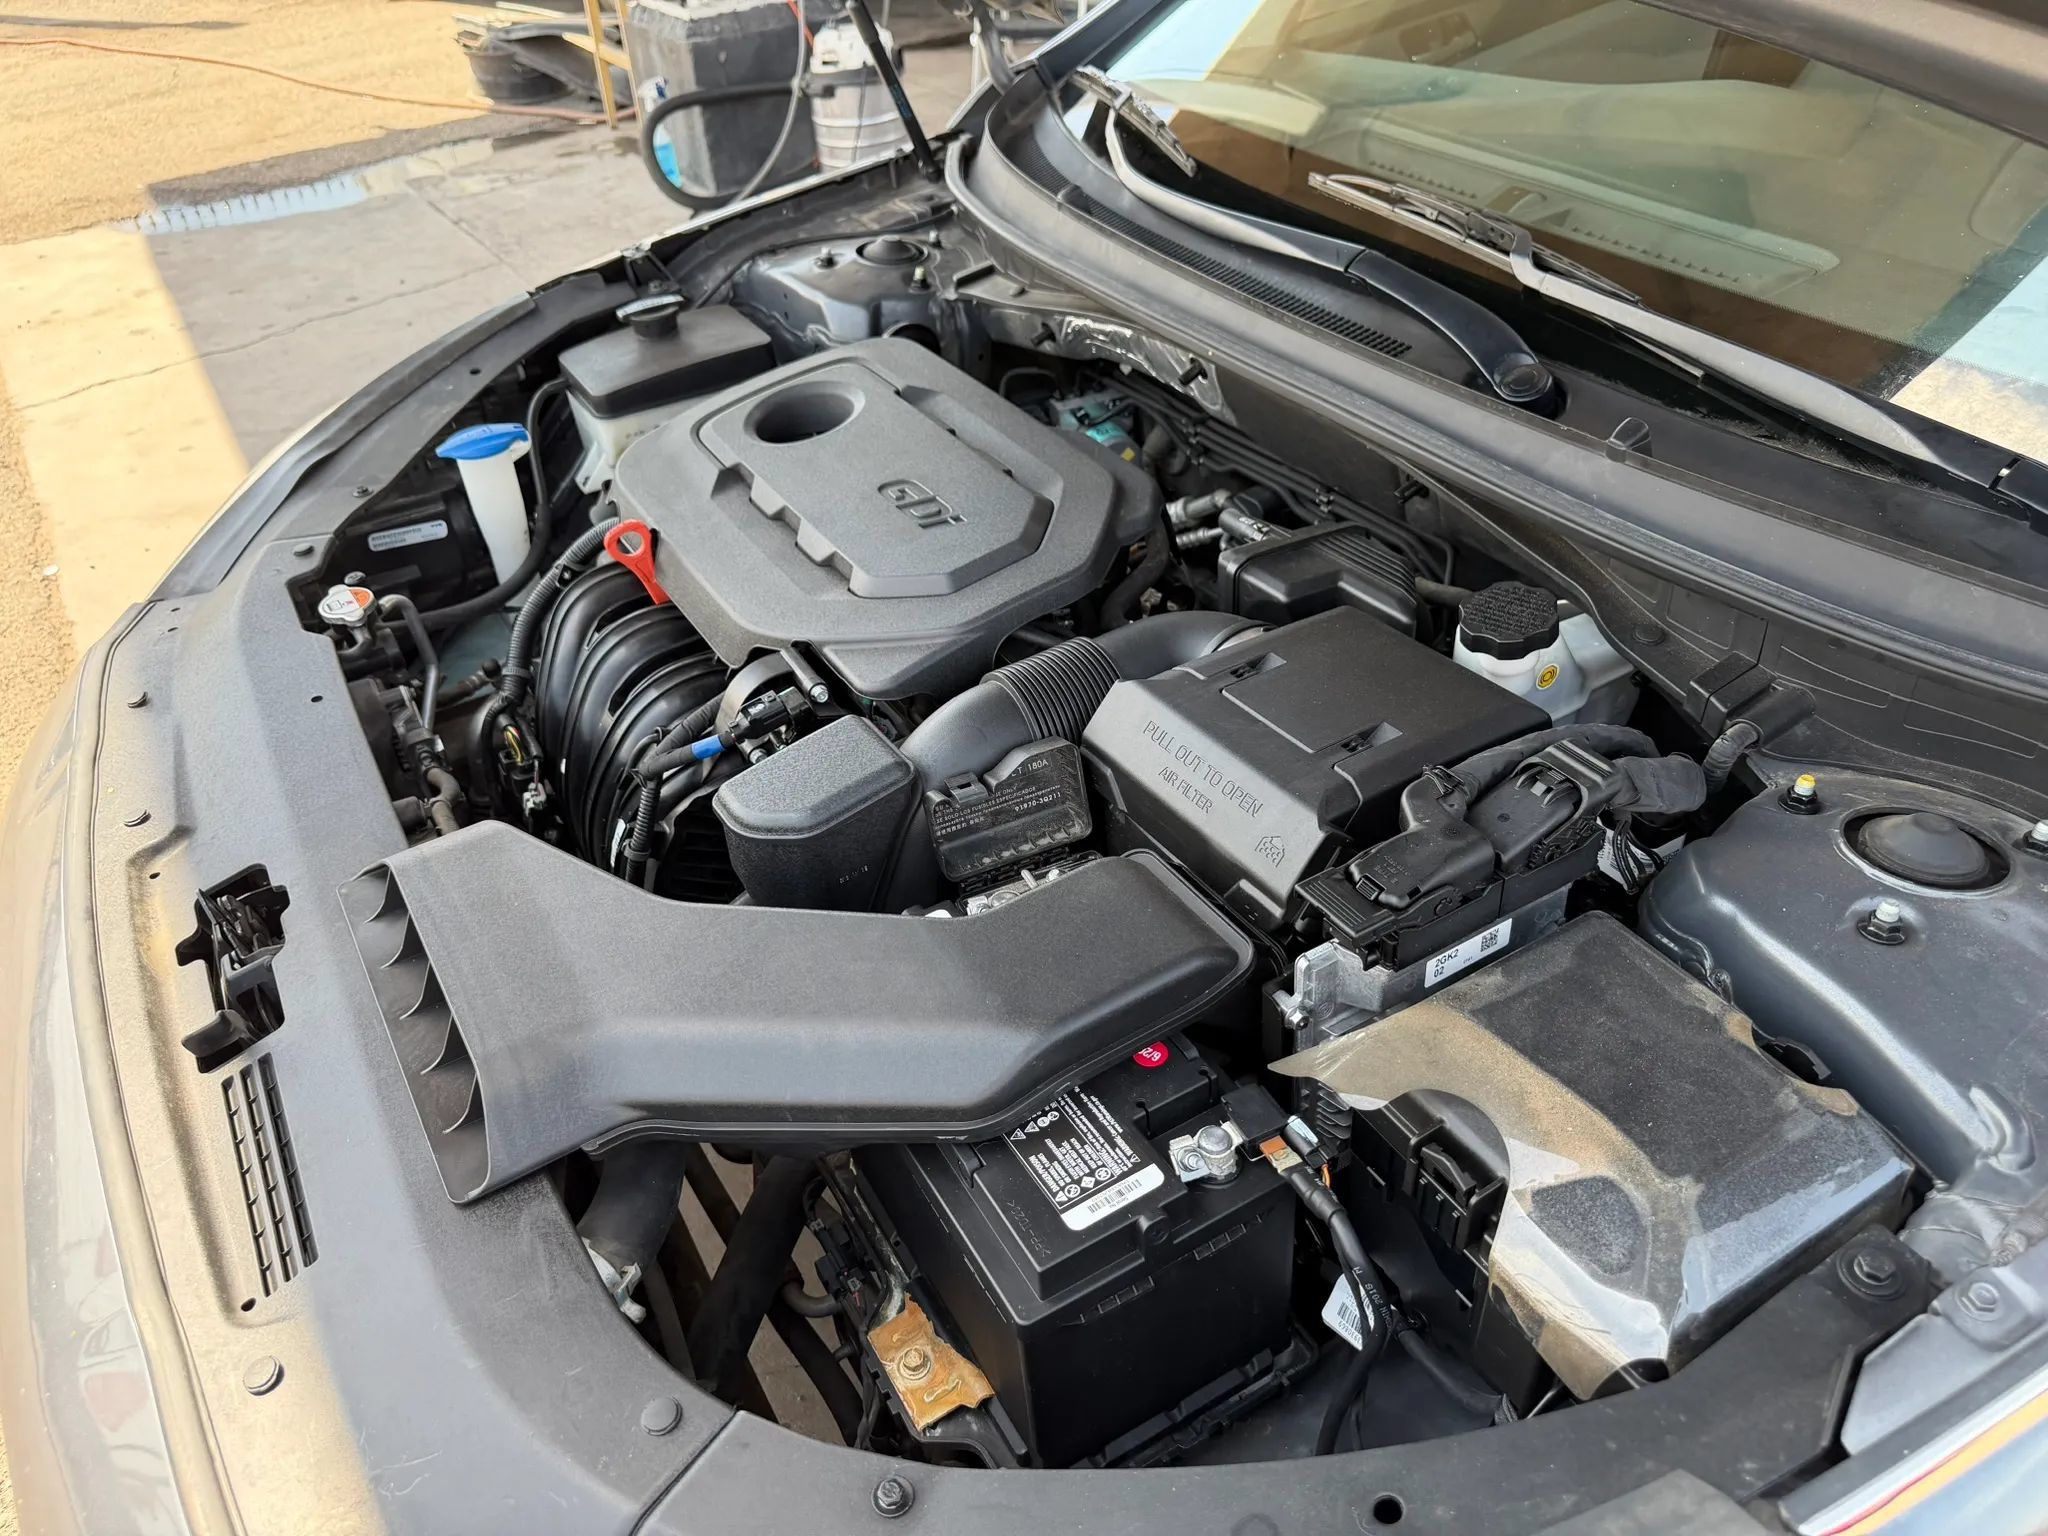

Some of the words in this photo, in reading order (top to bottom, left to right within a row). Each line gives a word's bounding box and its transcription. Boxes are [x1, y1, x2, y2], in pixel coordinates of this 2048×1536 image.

[1028, 758, 1049, 772] 180A
[1143, 721, 1175, 753] PULL
[1175, 745, 1205, 772] OUT
[1203, 765, 1223, 787] TO
[1222, 780, 1263, 817] OPEN
[1158, 767, 1179, 787] AIR
[1177, 779, 1214, 813] FILTER
[943, 812, 959, 821] SOLO
[1435, 949, 1459, 968] 2GK2
[1433, 966, 1444, 978] 02
[1027, 1154, 1060, 1192] DANGER/POISON
